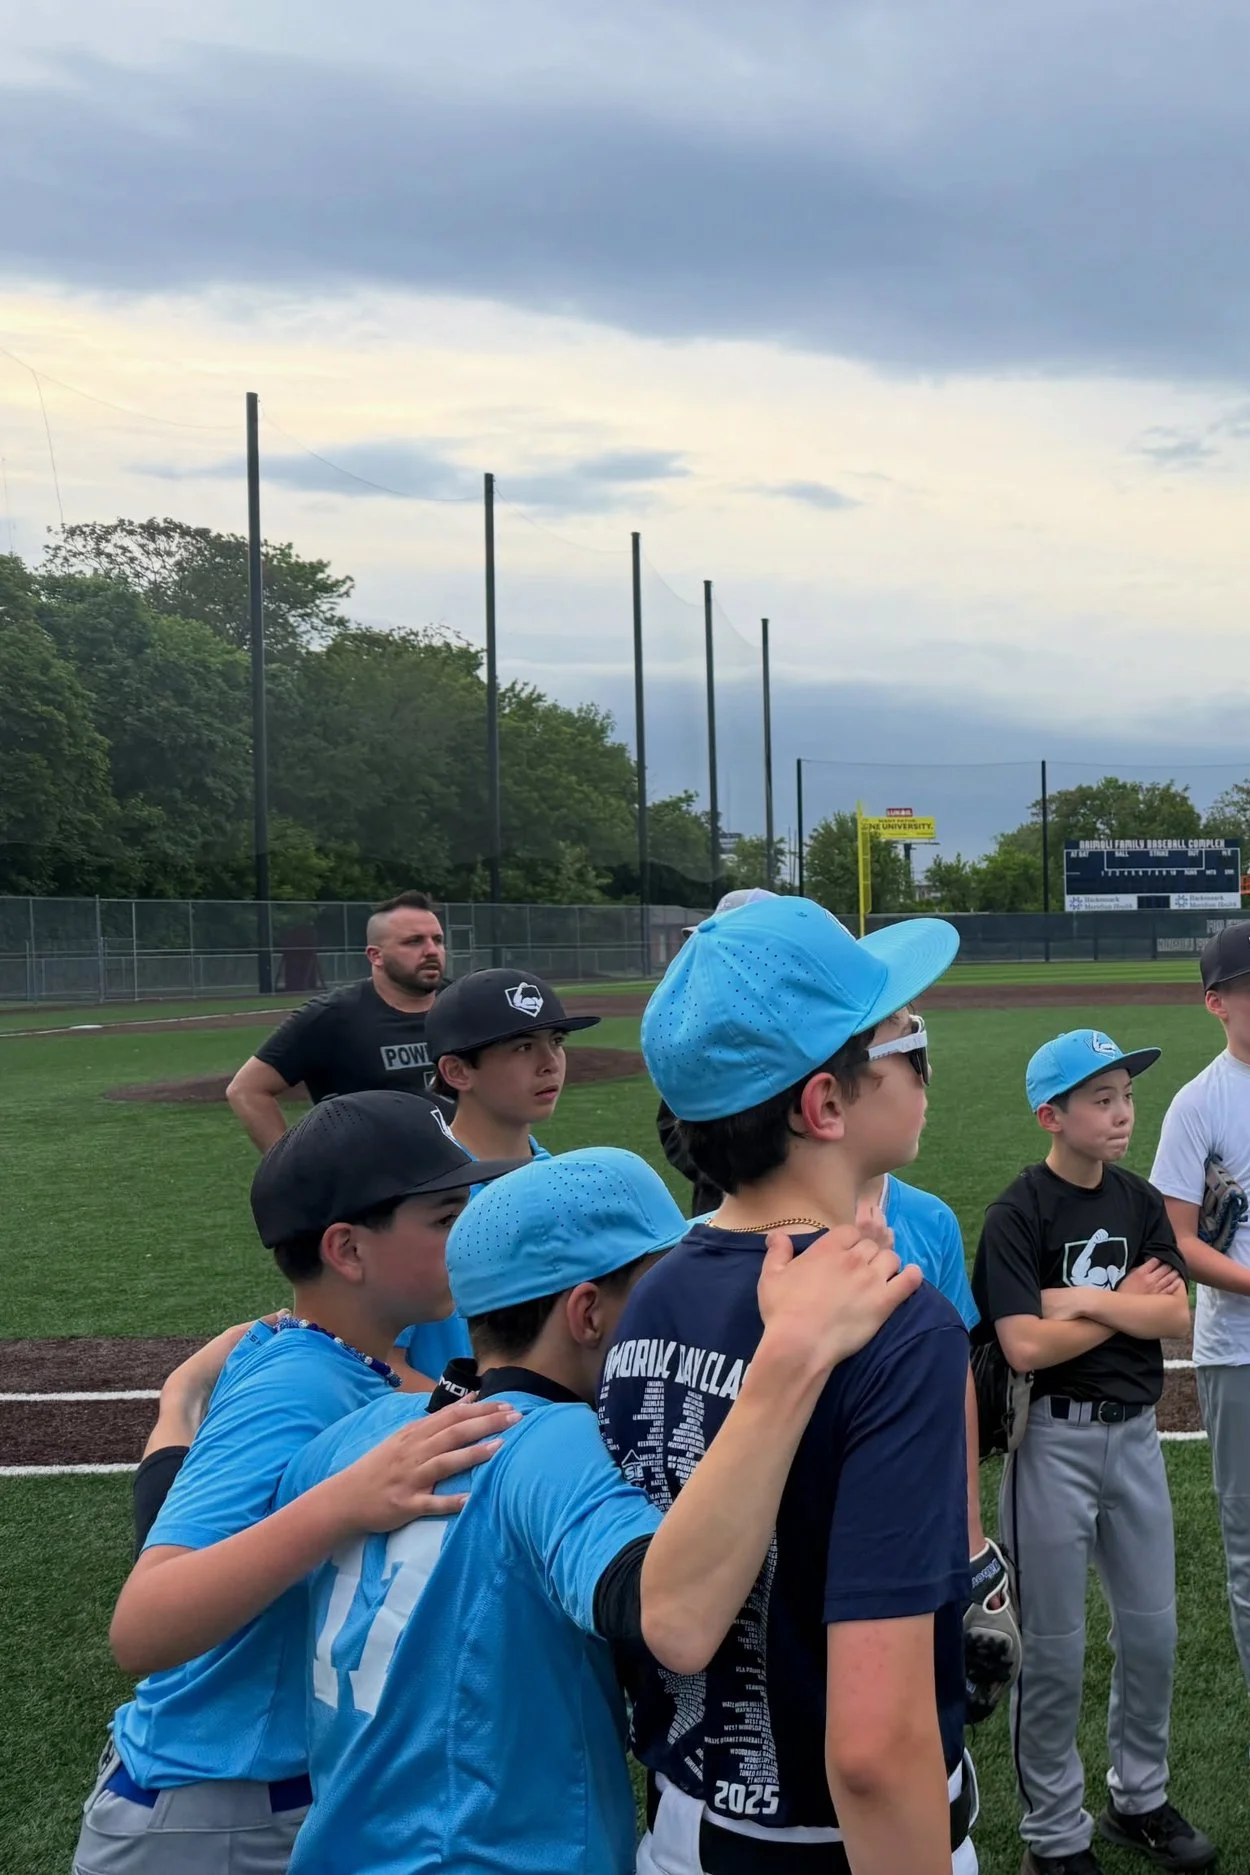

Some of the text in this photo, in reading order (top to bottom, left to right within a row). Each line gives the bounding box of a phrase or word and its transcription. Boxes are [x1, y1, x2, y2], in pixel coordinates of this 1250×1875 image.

[1115, 839, 1145, 849] FAMILY
[1147, 839, 1186, 848] BASEBALL
[1188, 838, 1225, 848] COMPLEX
[714, 1780, 780, 1815] 2025
